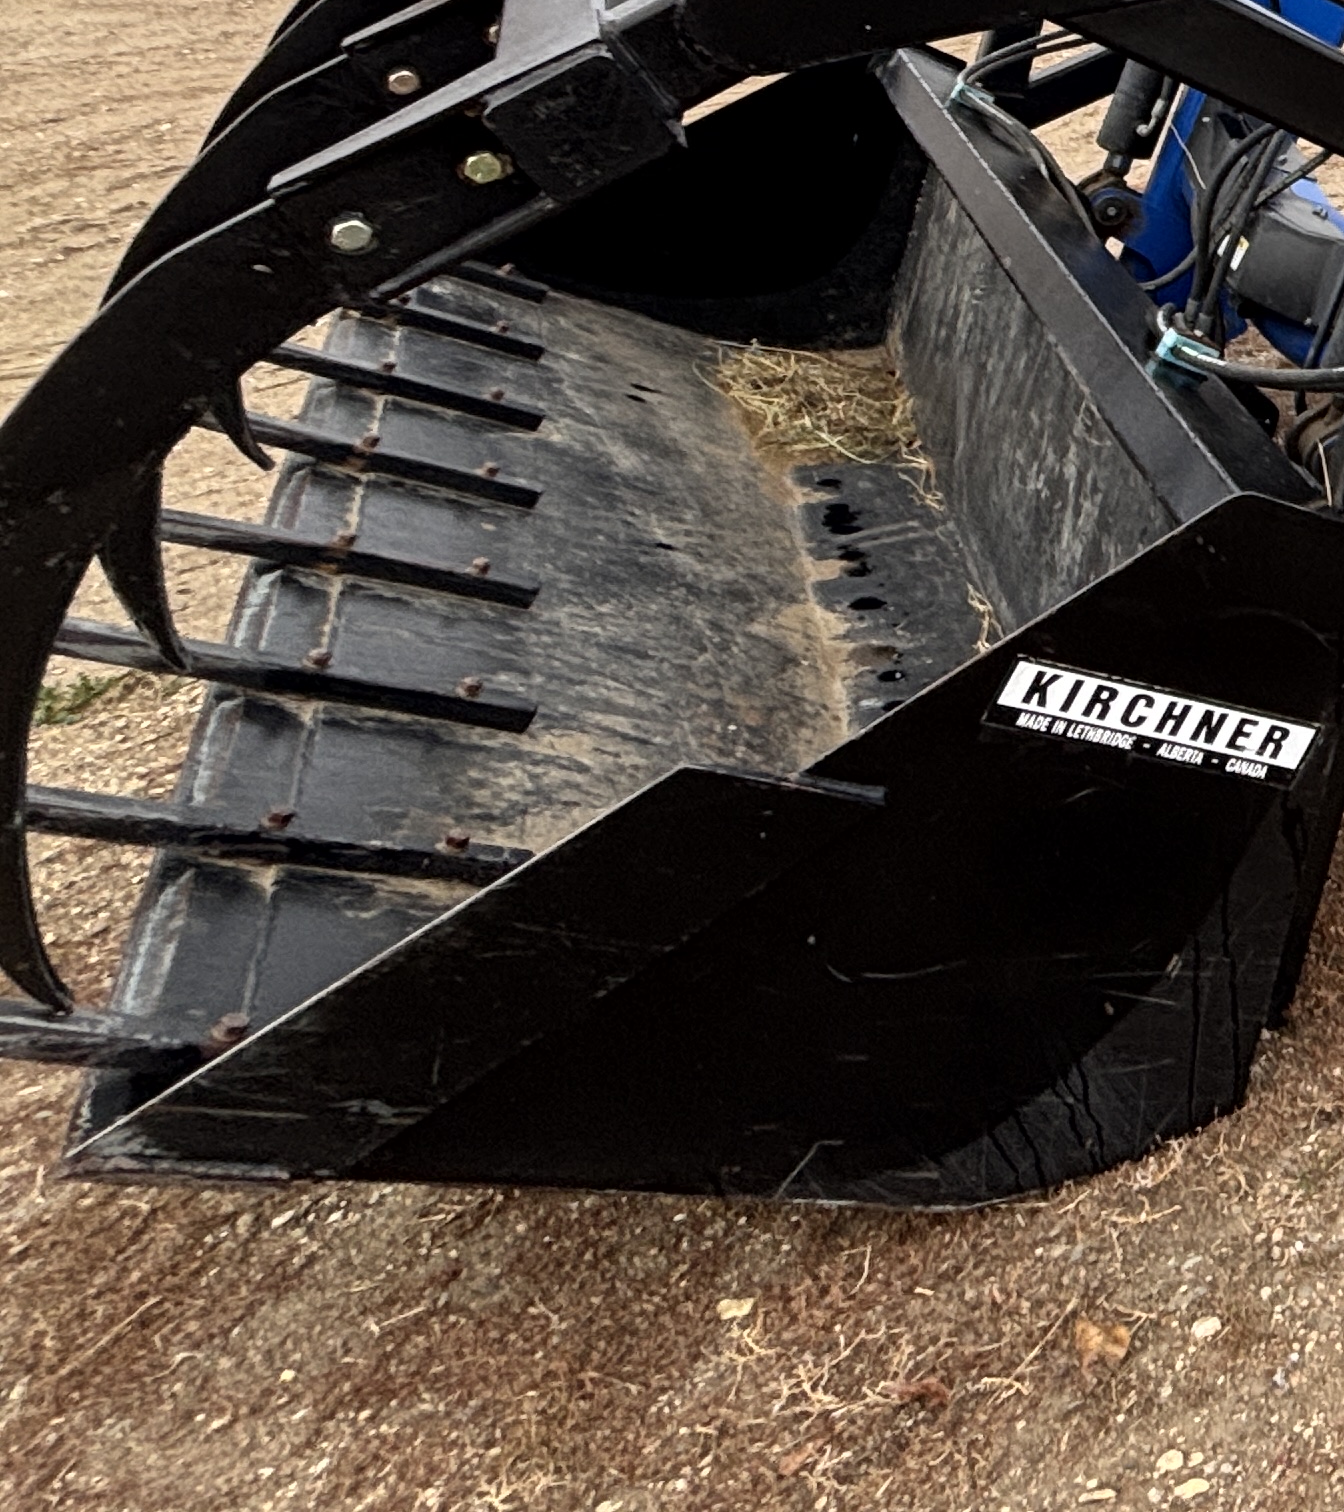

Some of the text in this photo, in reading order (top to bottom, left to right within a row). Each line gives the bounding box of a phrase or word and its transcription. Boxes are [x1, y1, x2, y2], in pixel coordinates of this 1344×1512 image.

[1015, 712, 1050, 733] MADE
[1051, 719, 1065, 735] IN
[1066, 722, 1136, 750] LETHBRIDGE
[1155, 741, 1204, 765] ALBERTA
[1225, 757, 1268, 779] CANADA
[1022, 670, 1291, 760] KIRCHNER
